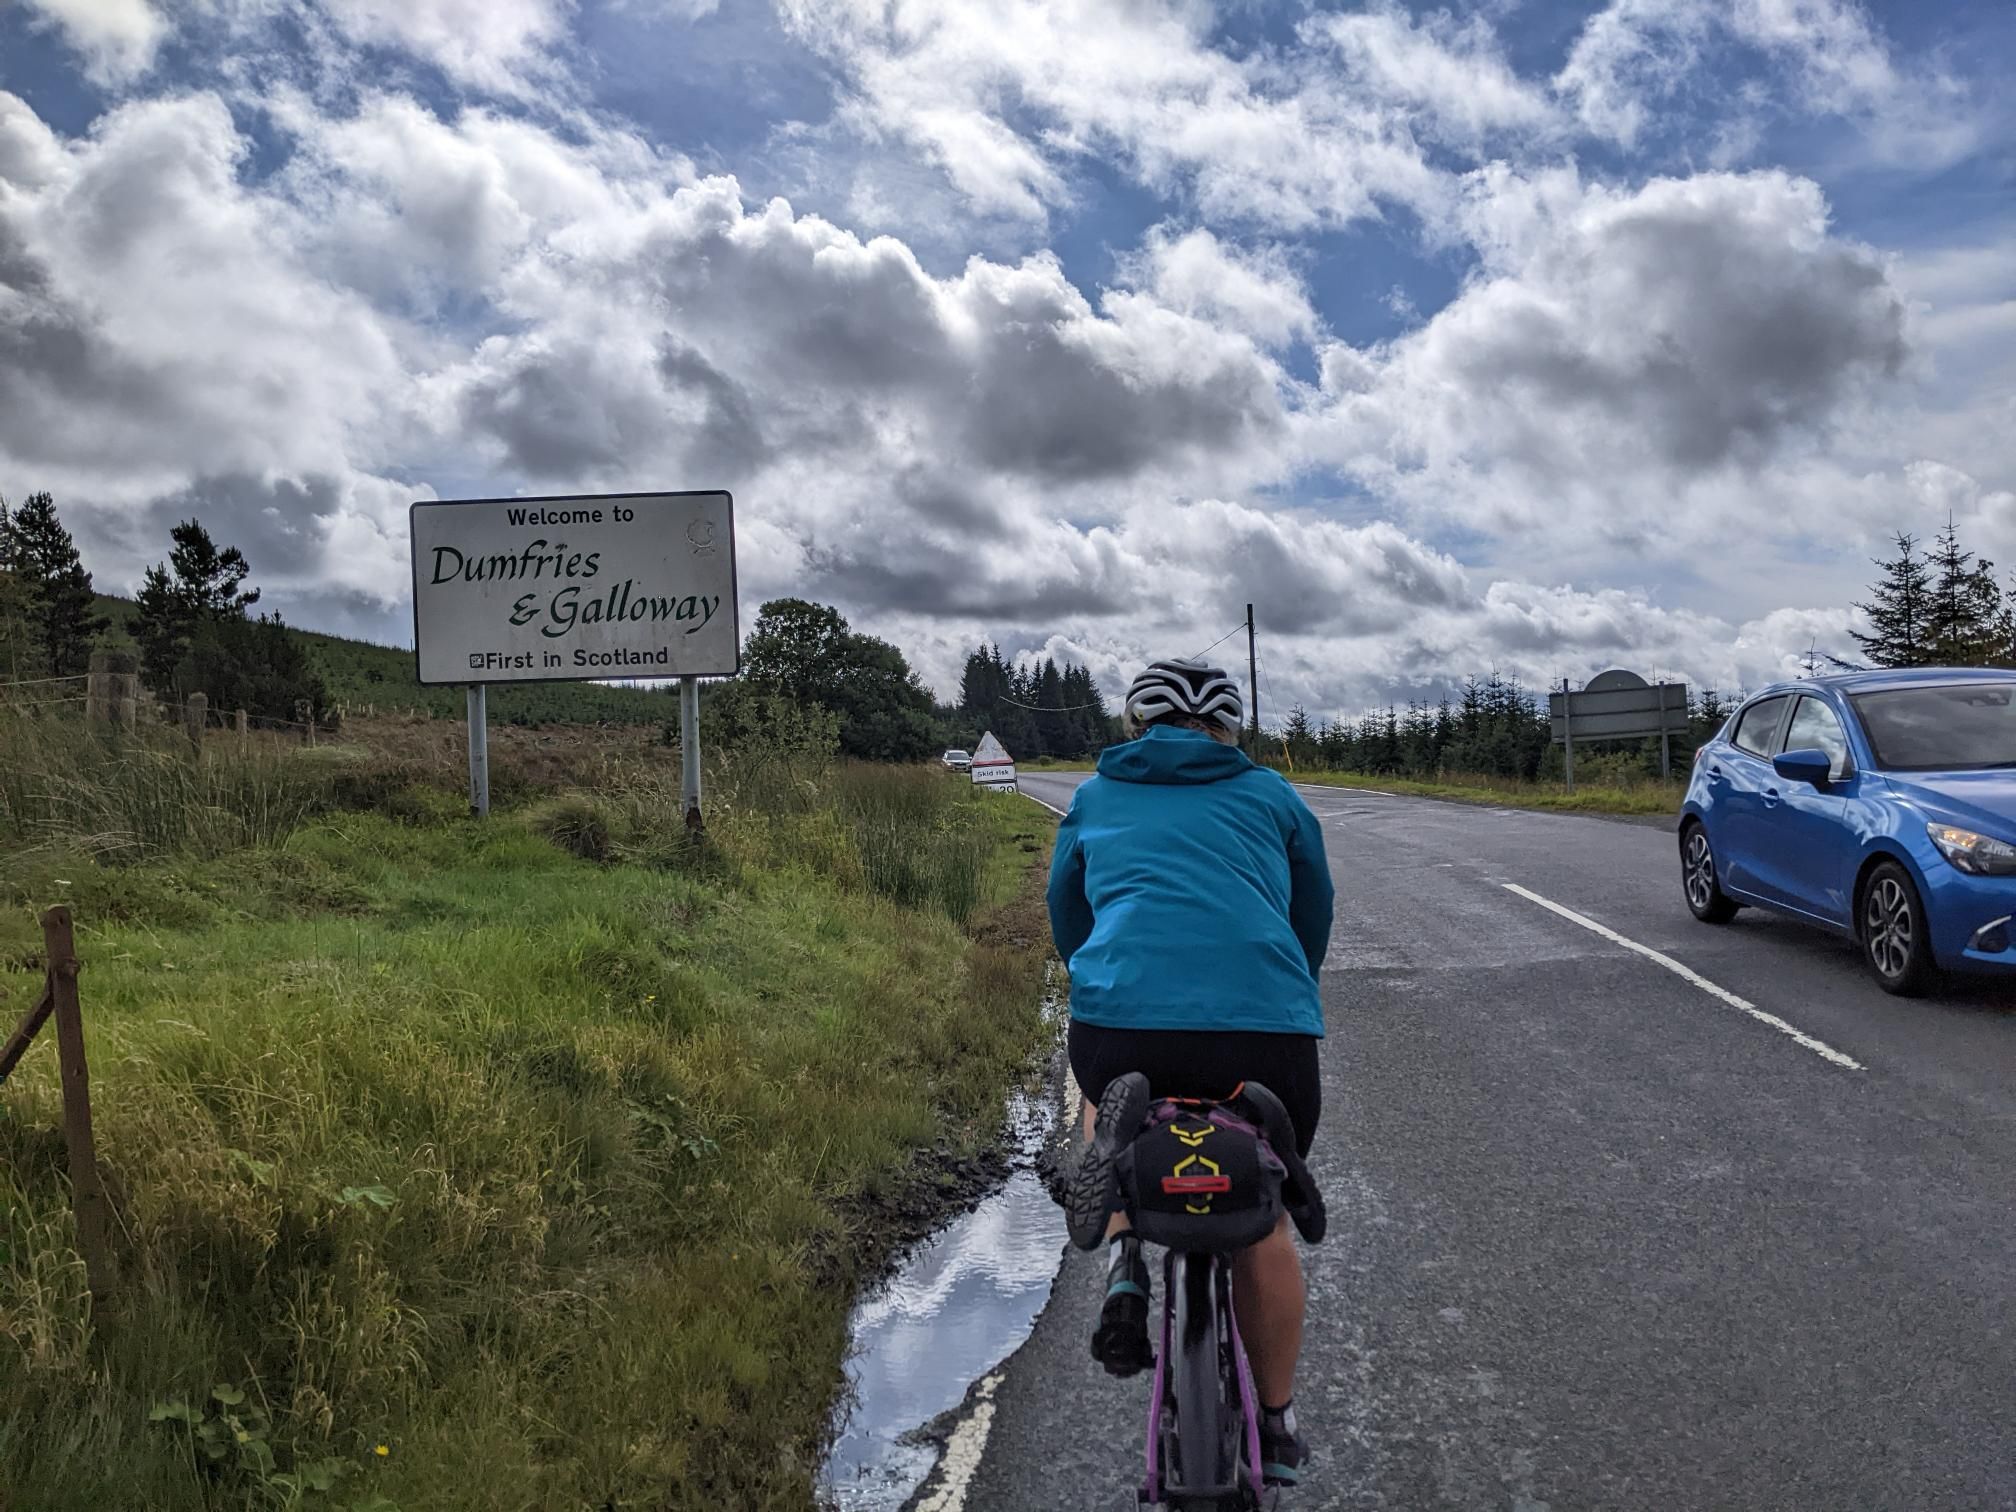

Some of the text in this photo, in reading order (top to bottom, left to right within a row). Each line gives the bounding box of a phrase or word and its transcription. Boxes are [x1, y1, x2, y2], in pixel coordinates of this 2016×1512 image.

[507, 505, 634, 526] Welcome to
[430, 539, 601, 585] Dumfries
[509, 579, 720, 638] & Galloway
[486, 647, 668, 670] First in Scotland
